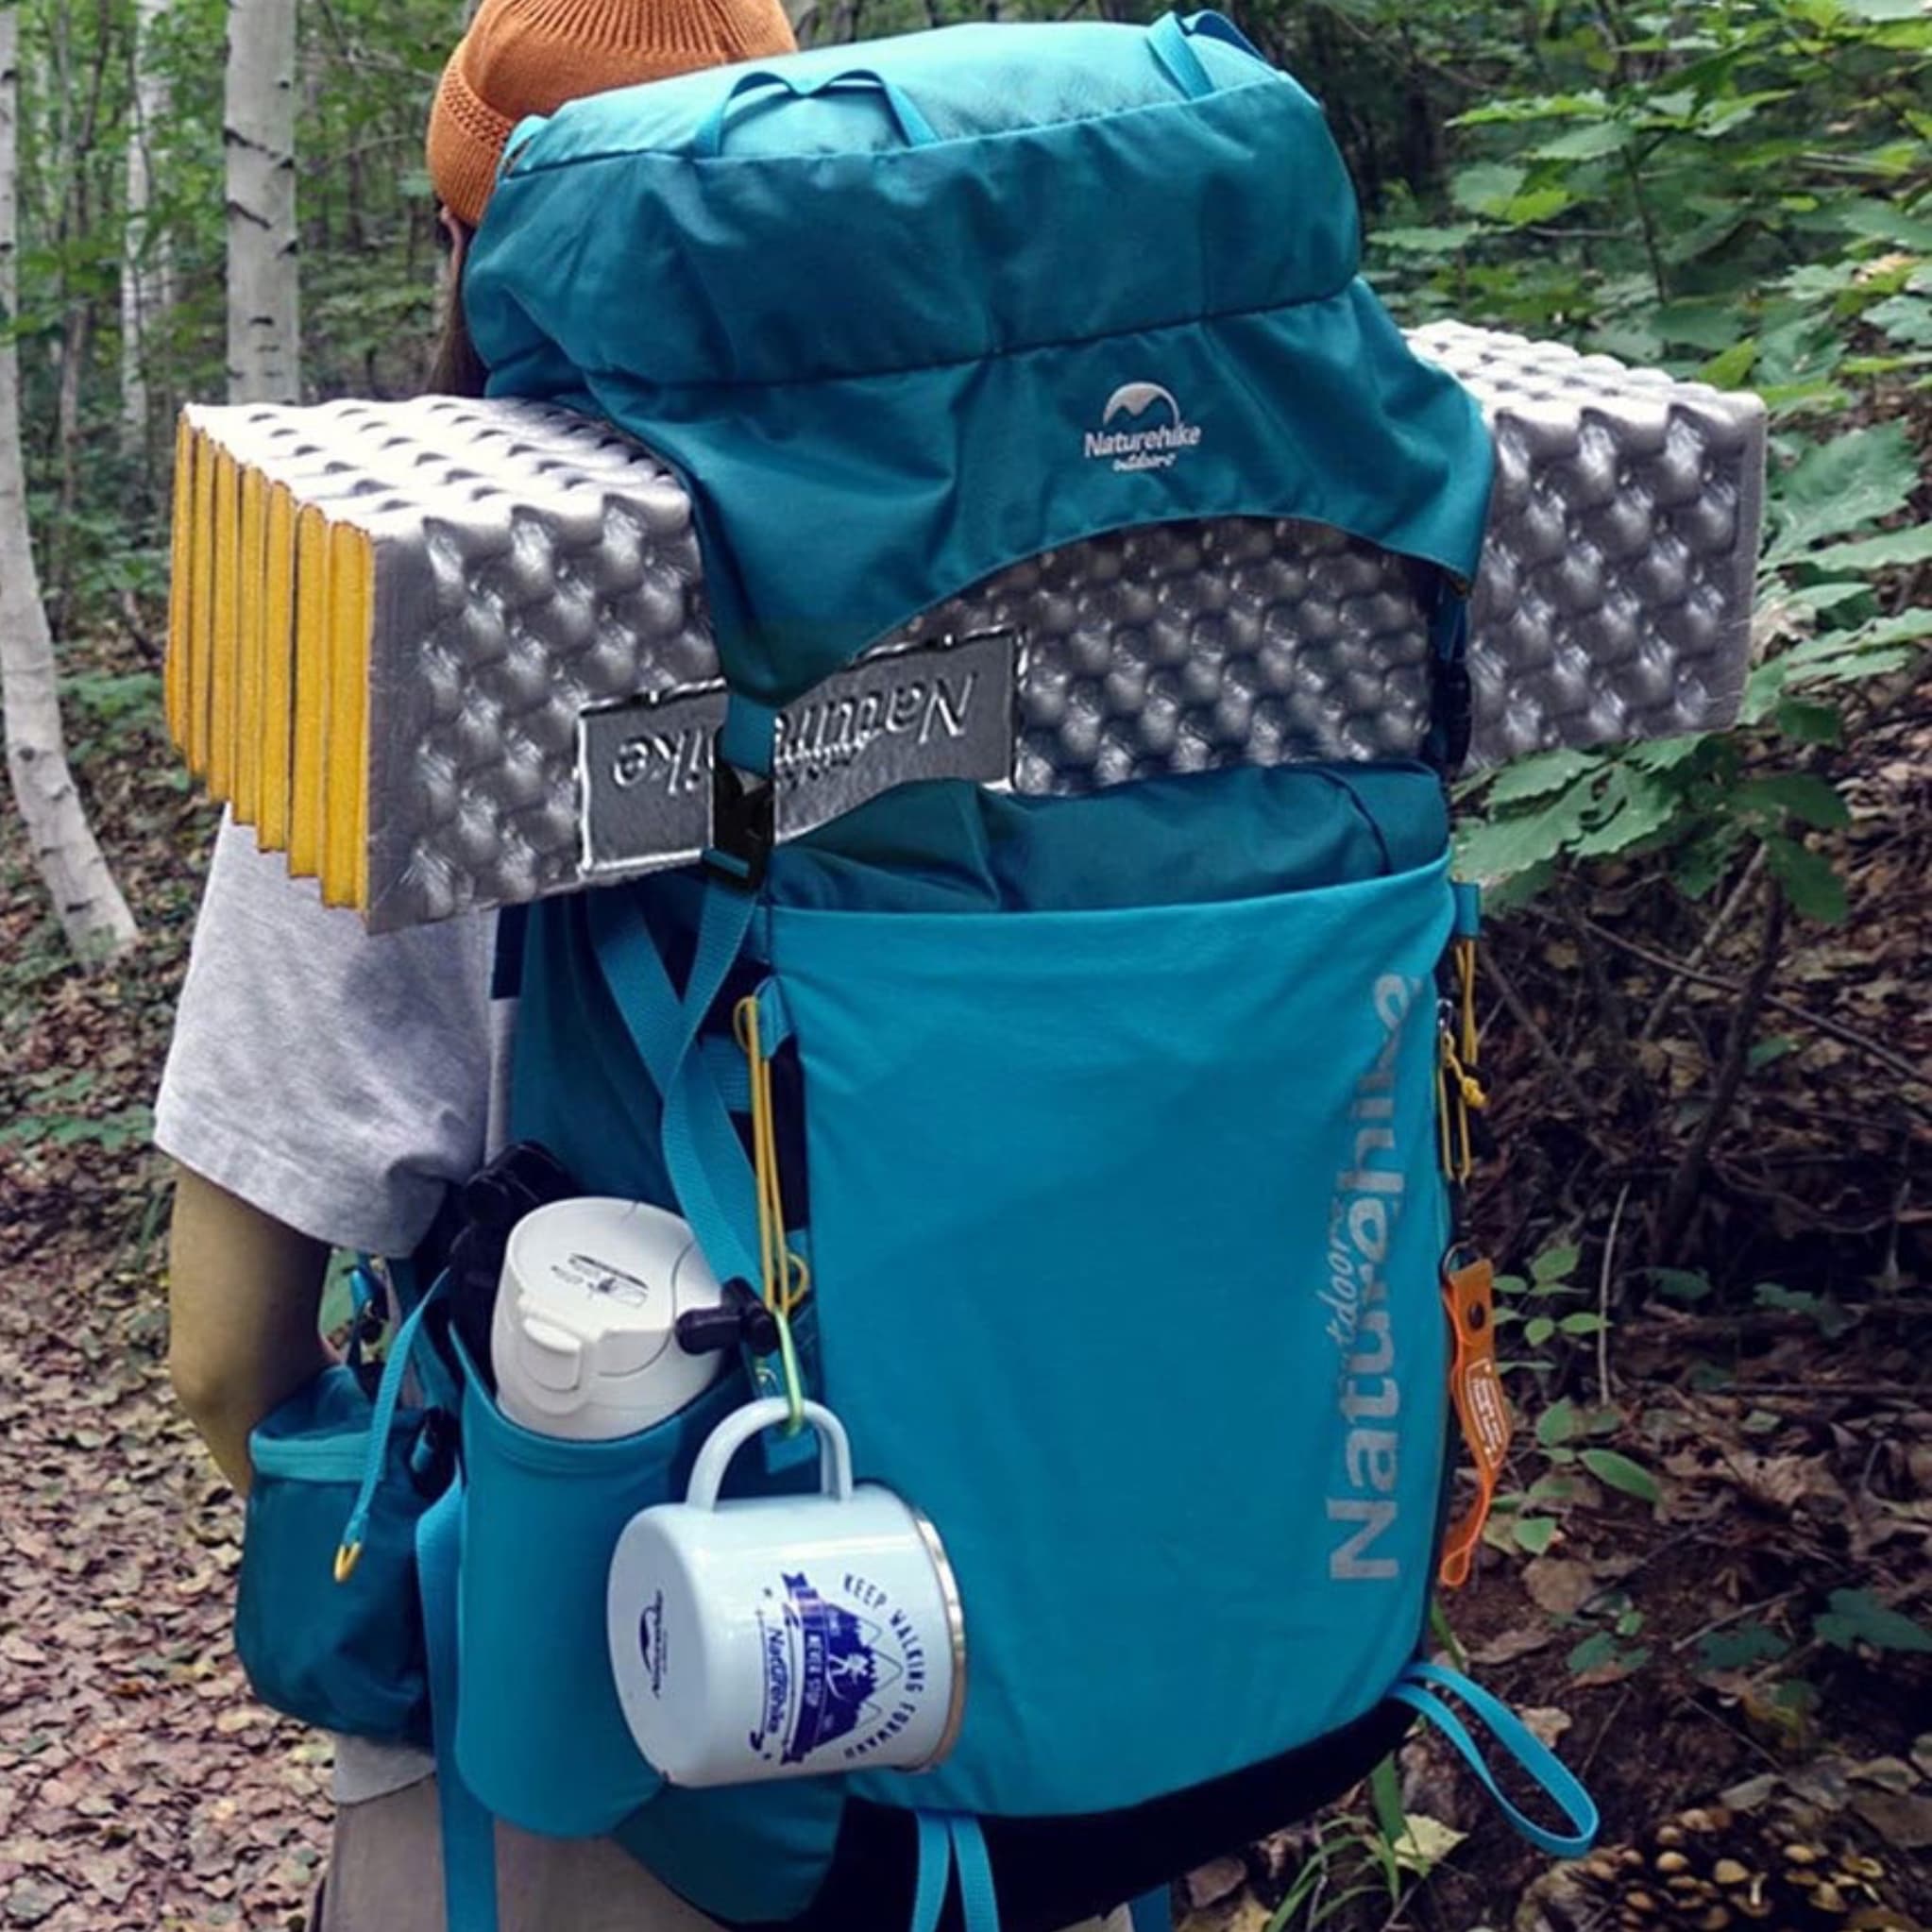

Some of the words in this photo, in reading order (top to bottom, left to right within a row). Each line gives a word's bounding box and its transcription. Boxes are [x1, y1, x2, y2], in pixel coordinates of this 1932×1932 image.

[1085, 424, 1201, 458] Naturehike
[843, 1573, 888, 1610] KEEP
[889, 1608, 924, 1693] WALKING
